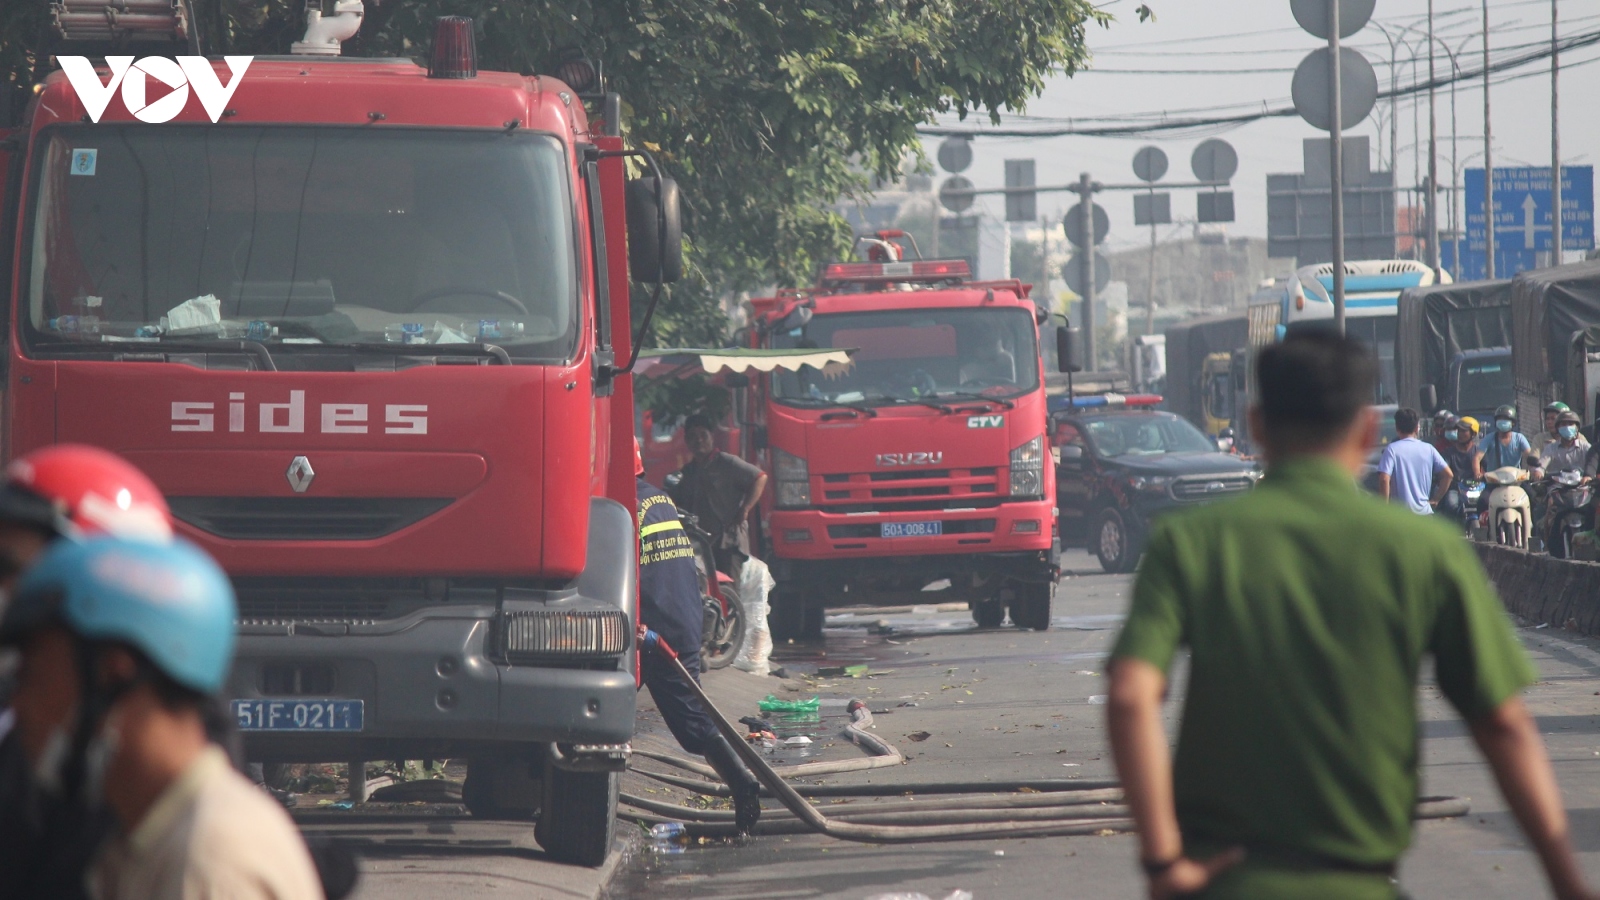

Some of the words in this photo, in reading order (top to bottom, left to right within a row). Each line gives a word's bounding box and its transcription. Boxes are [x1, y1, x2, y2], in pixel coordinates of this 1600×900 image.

[171, 390, 428, 434] sides
[967, 415, 1003, 428] CTV
[876, 451, 943, 467] ISUZU
[883, 522, 939, 537] 50A-008.41
